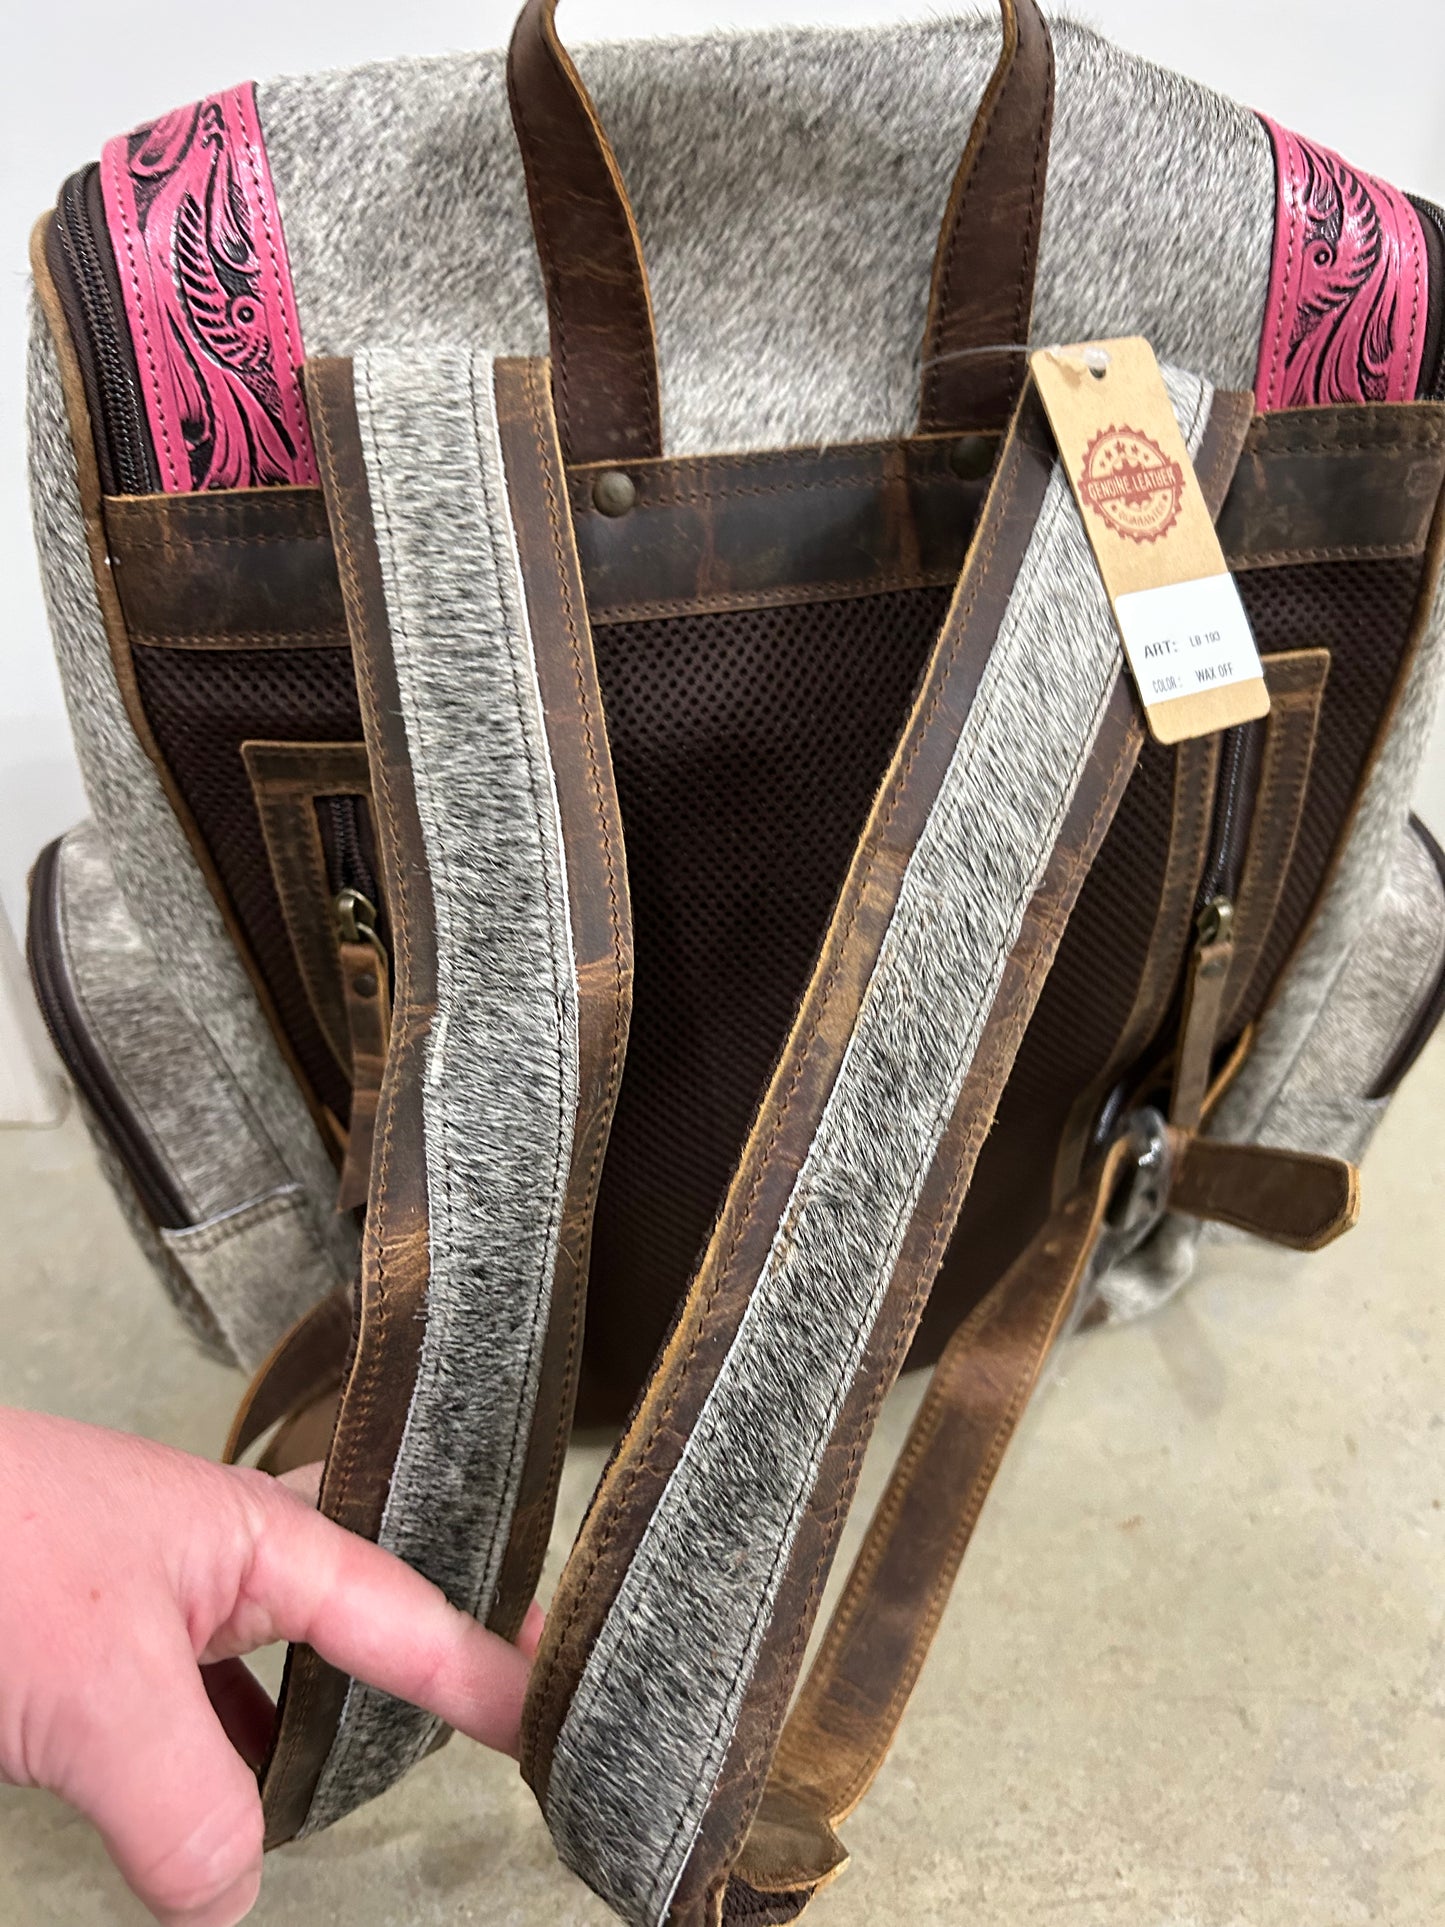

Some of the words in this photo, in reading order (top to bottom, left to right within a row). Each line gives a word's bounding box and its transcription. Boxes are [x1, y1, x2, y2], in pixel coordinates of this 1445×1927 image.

[1088, 476, 1132, 501] GENUINE
[1132, 466, 1176, 492] LEATHER
[1144, 640, 1178, 659] ART:
[1195, 666, 1216, 683] WAX
[1218, 661, 1234, 678] OFF
